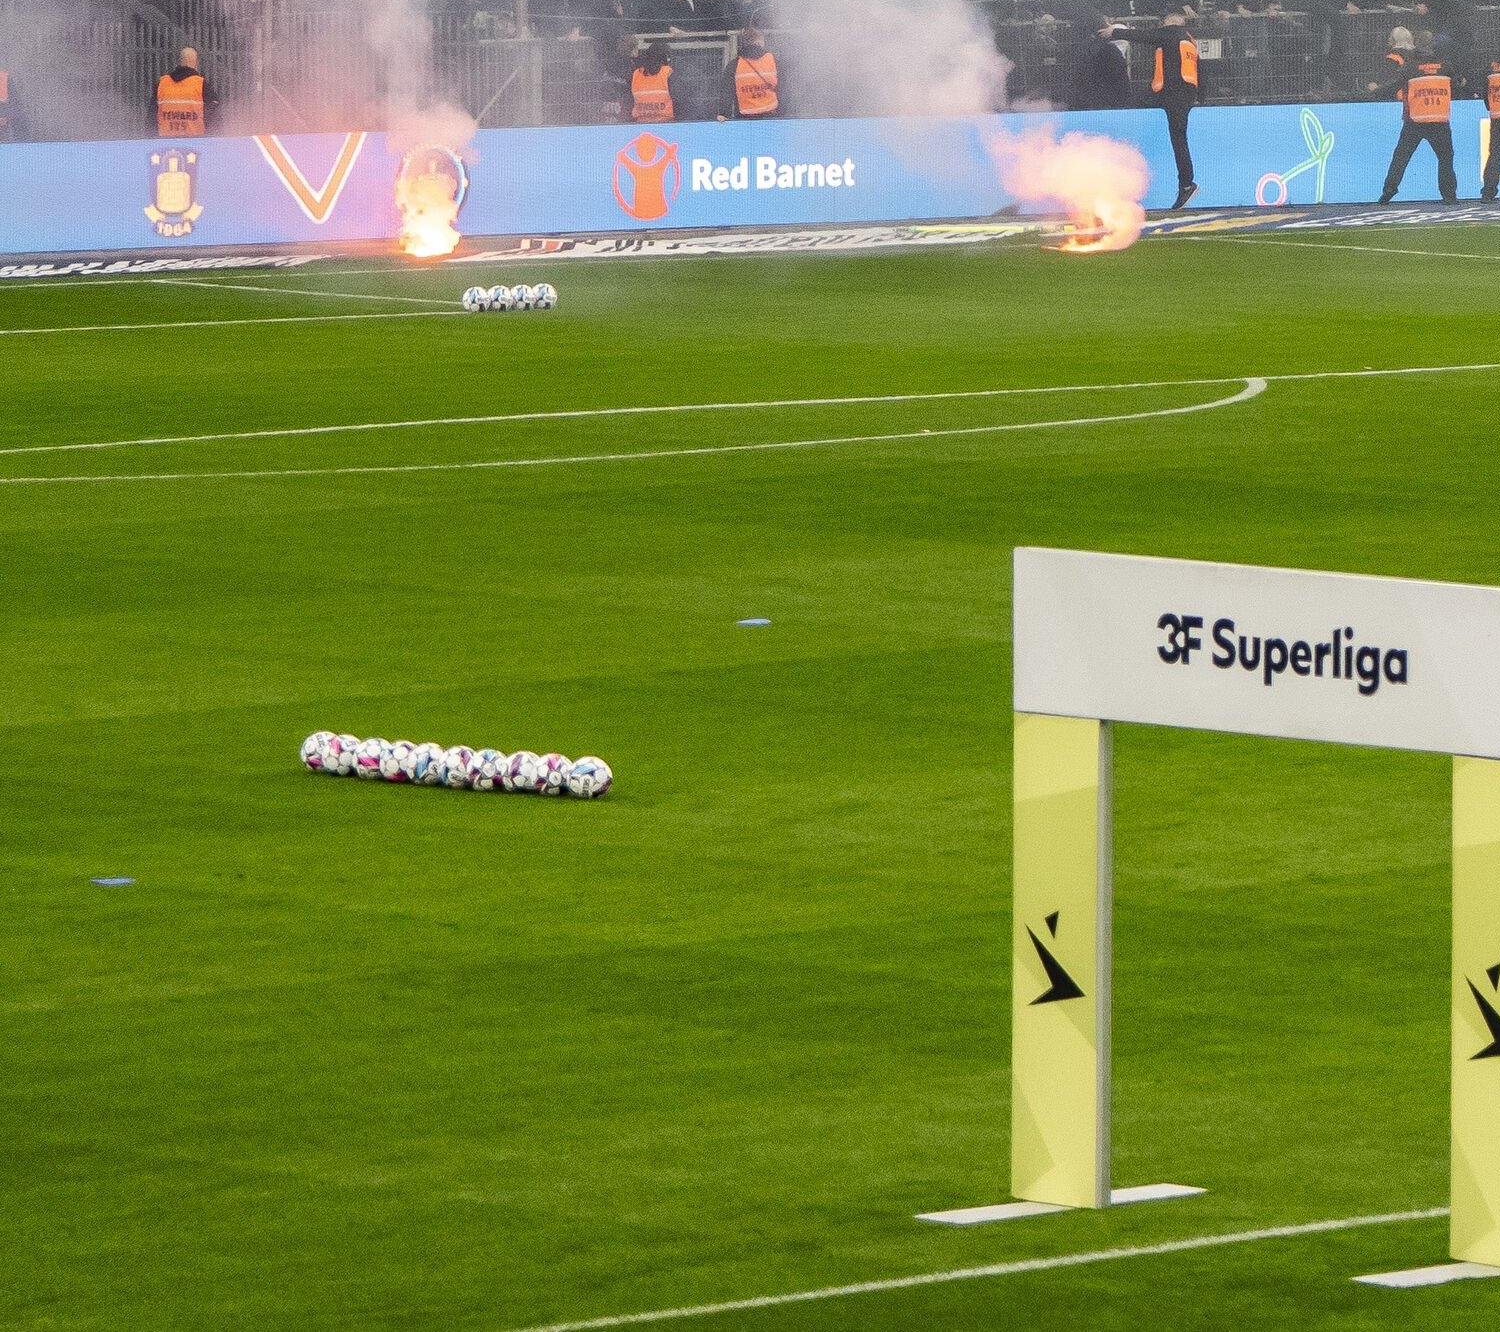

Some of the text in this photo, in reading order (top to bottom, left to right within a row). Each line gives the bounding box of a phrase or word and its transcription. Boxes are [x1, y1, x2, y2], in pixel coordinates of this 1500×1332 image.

[163, 110, 198, 121] TEWARD
[692, 156, 854, 191] Red Barnet
[1157, 613, 1408, 695] 3F Superliga
